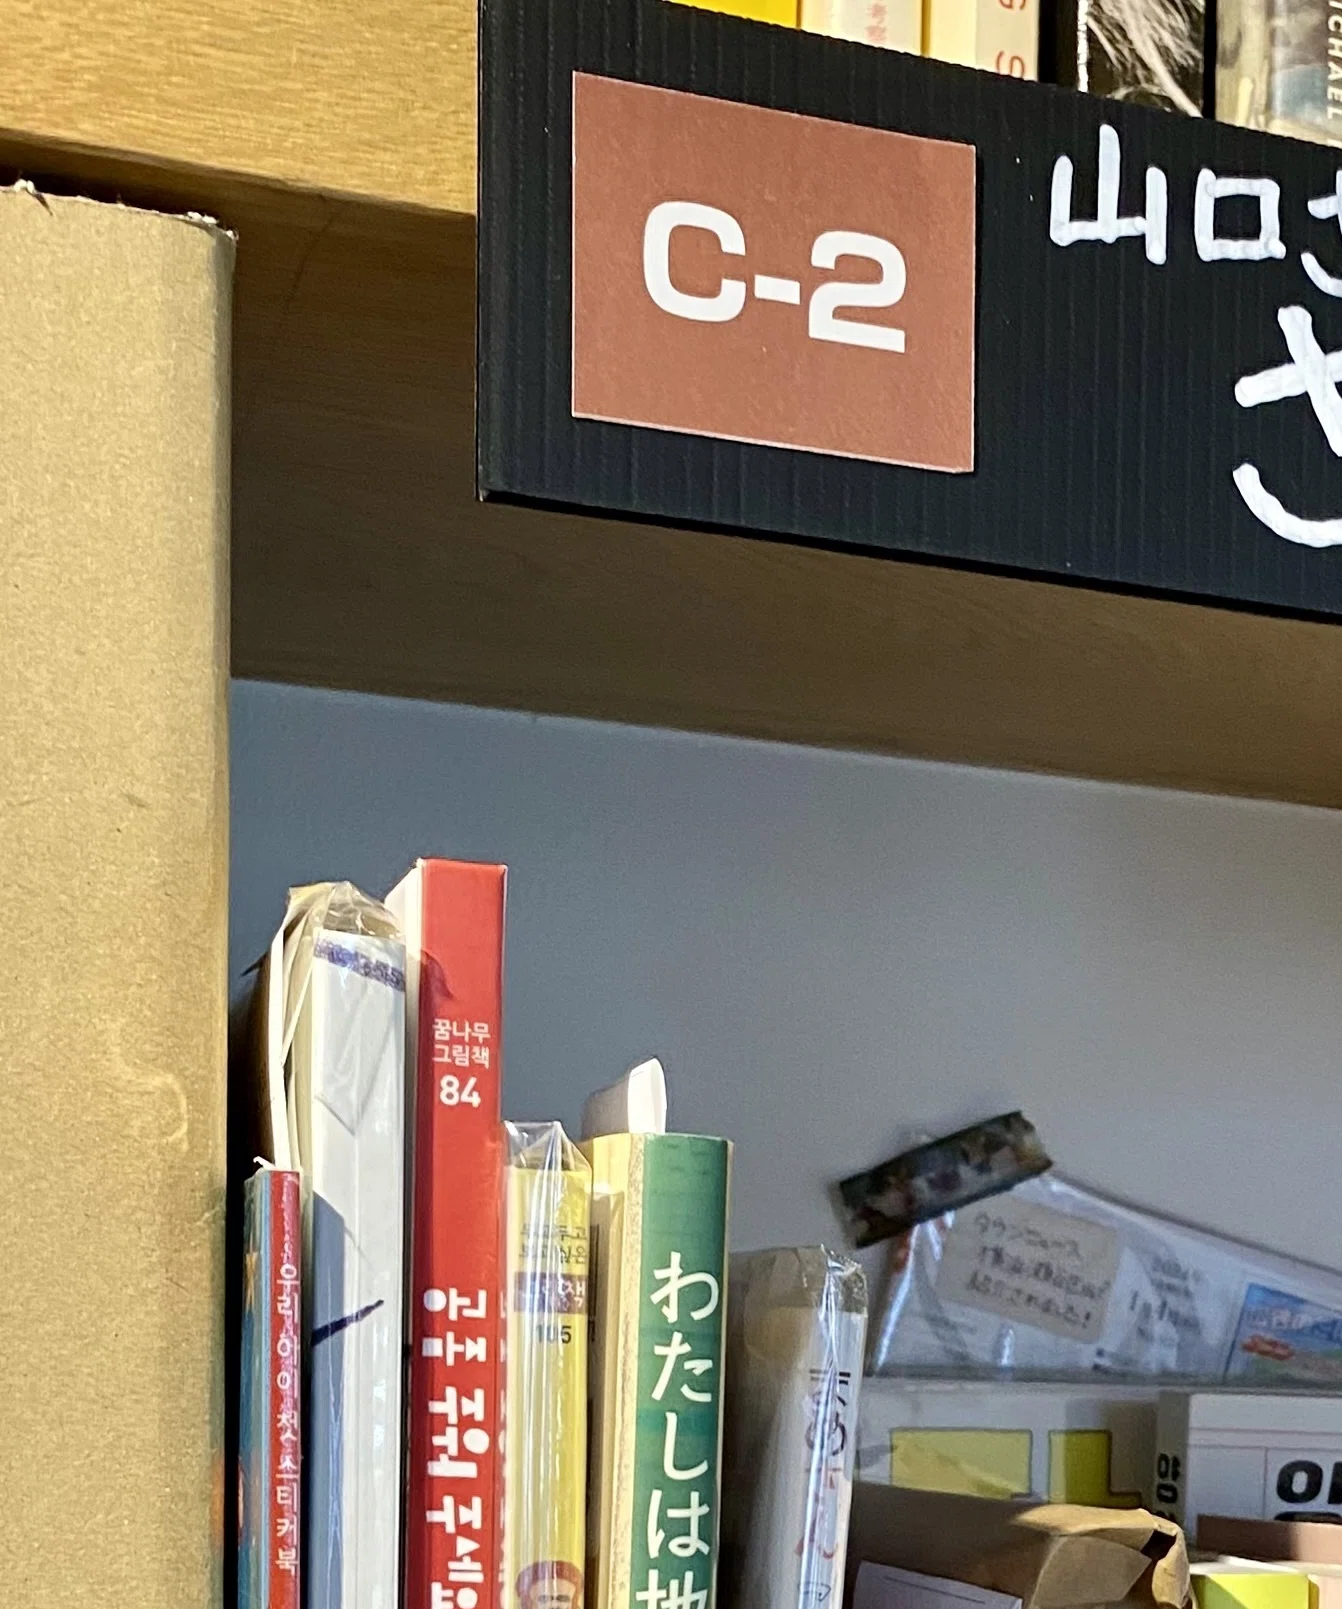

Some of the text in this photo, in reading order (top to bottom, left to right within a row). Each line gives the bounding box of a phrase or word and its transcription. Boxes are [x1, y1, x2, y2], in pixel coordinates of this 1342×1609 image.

[642, 201, 907, 354] C-2
[432, 1018, 491, 1042] 꿈나무
[432, 1043, 490, 1068] 그림책
[439, 1075, 482, 1108] 84
[423, 1287, 486, 1322] 공
[423, 1330, 487, 1366] 좀
[427, 1386, 491, 1478] 주워
[275, 1545, 299, 1574] 북
